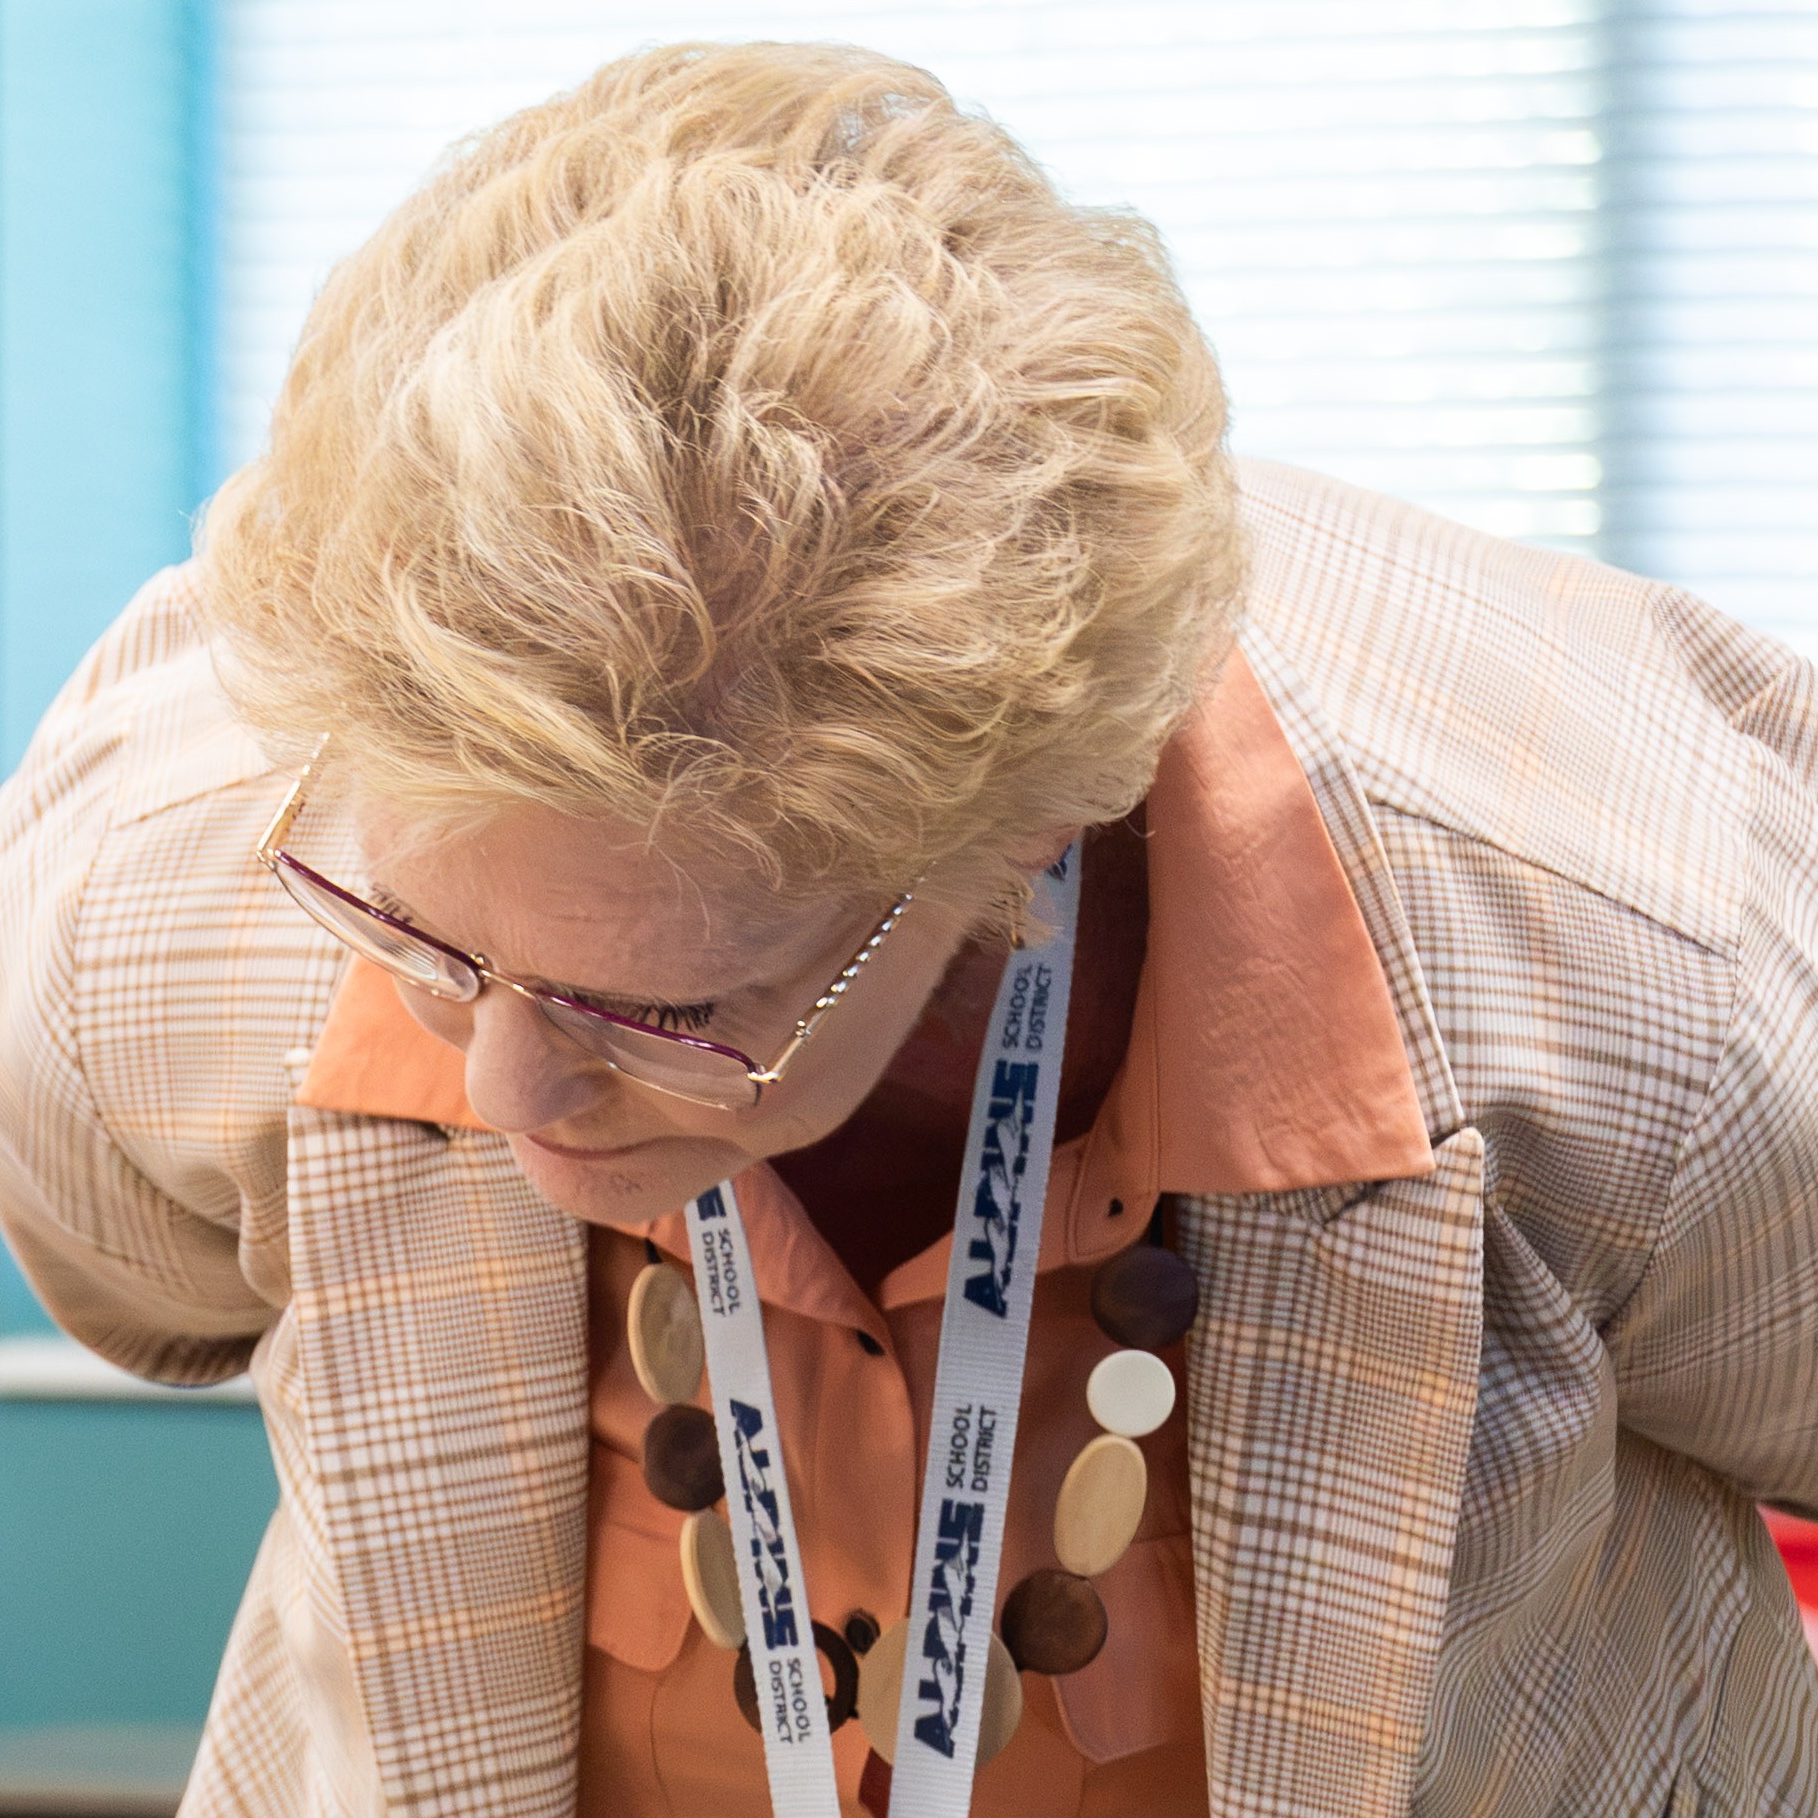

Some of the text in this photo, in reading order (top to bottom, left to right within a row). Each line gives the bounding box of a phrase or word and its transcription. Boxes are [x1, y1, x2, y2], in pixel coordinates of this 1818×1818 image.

[1002, 963, 1034, 1049] SCHOOL
[1025, 964, 1053, 1052] DISTRICT
[700, 1231, 725, 1317] DISTRICT
[717, 1228, 740, 1316] SCHOOL
[946, 1403, 973, 1489] SCHOOL
[971, 1405, 998, 1493] DISTRICT
[768, 1659, 794, 1746] DISTRICT
[786, 1657, 812, 1744] SCHOOL
